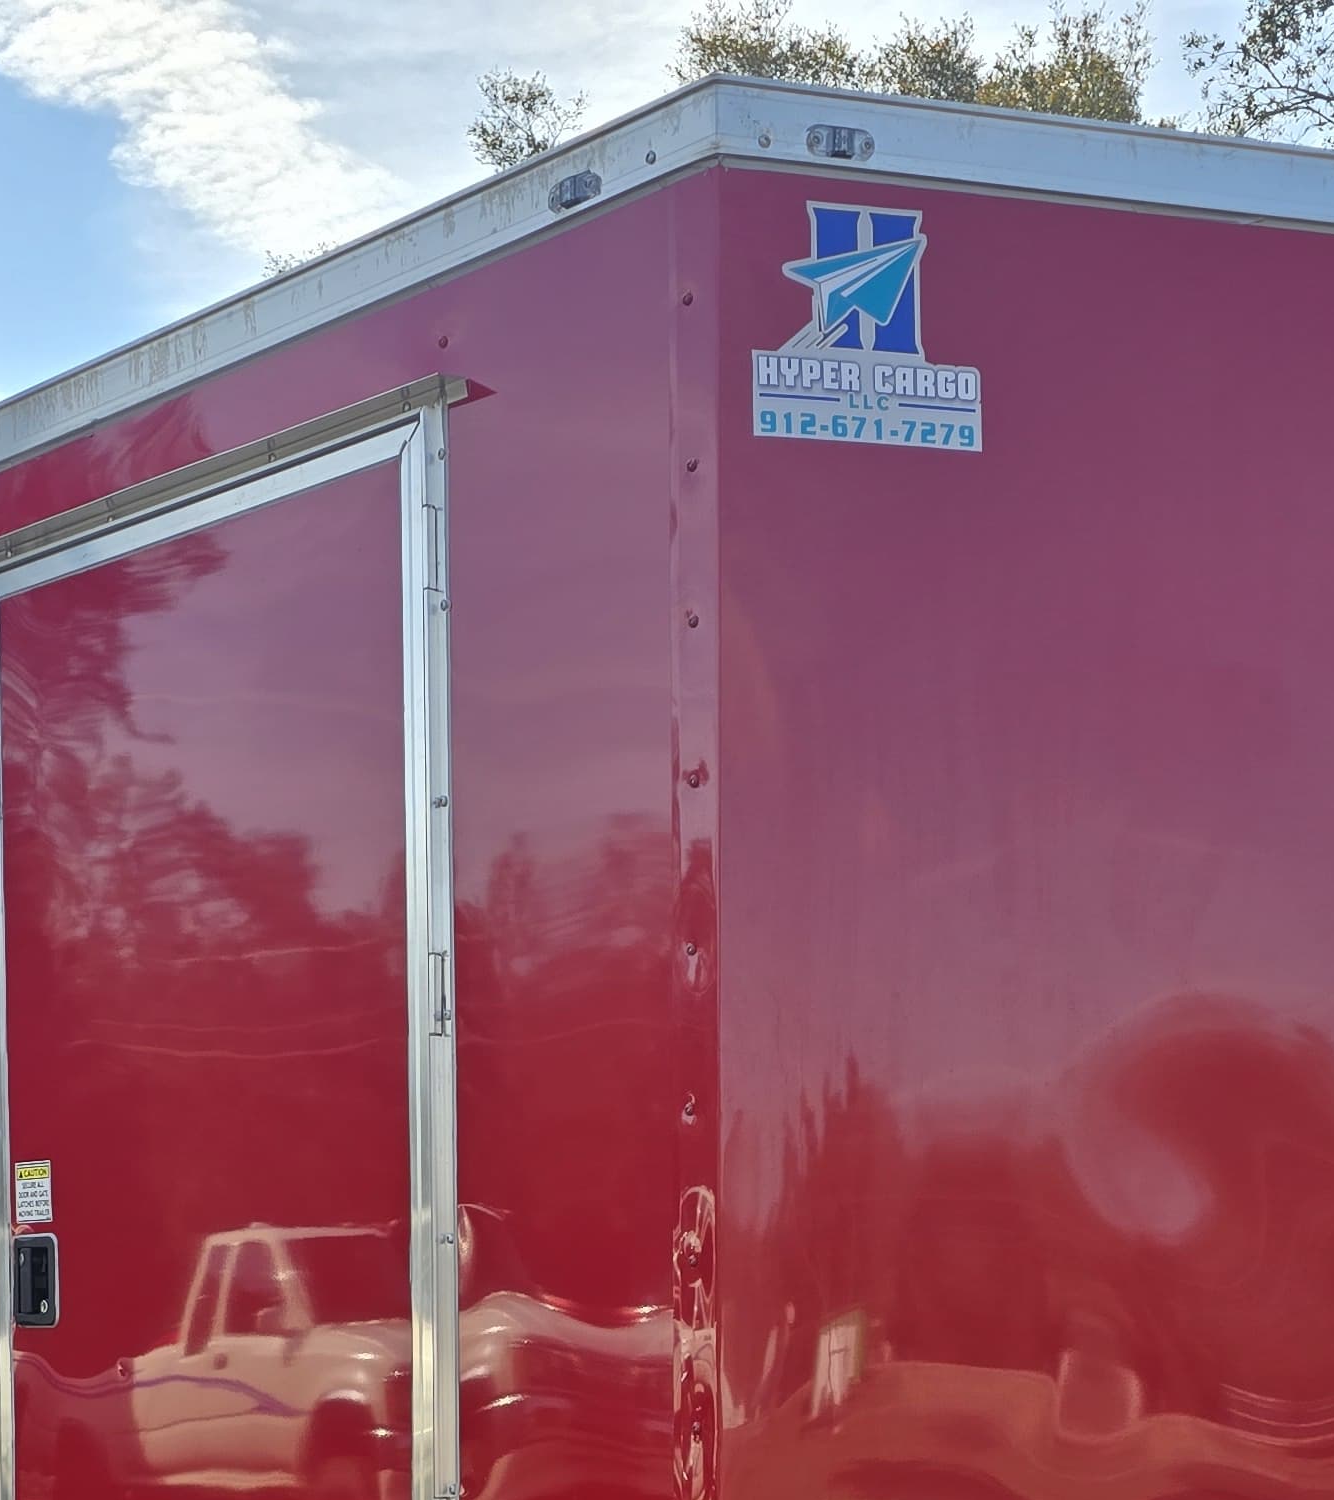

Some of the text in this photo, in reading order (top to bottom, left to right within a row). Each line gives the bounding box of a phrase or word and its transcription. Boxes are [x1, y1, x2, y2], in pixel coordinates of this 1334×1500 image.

[757, 355, 977, 402] HYPER CARGO
[848, 393, 890, 411] LLC
[759, 410, 975, 447] 912-671-7279
